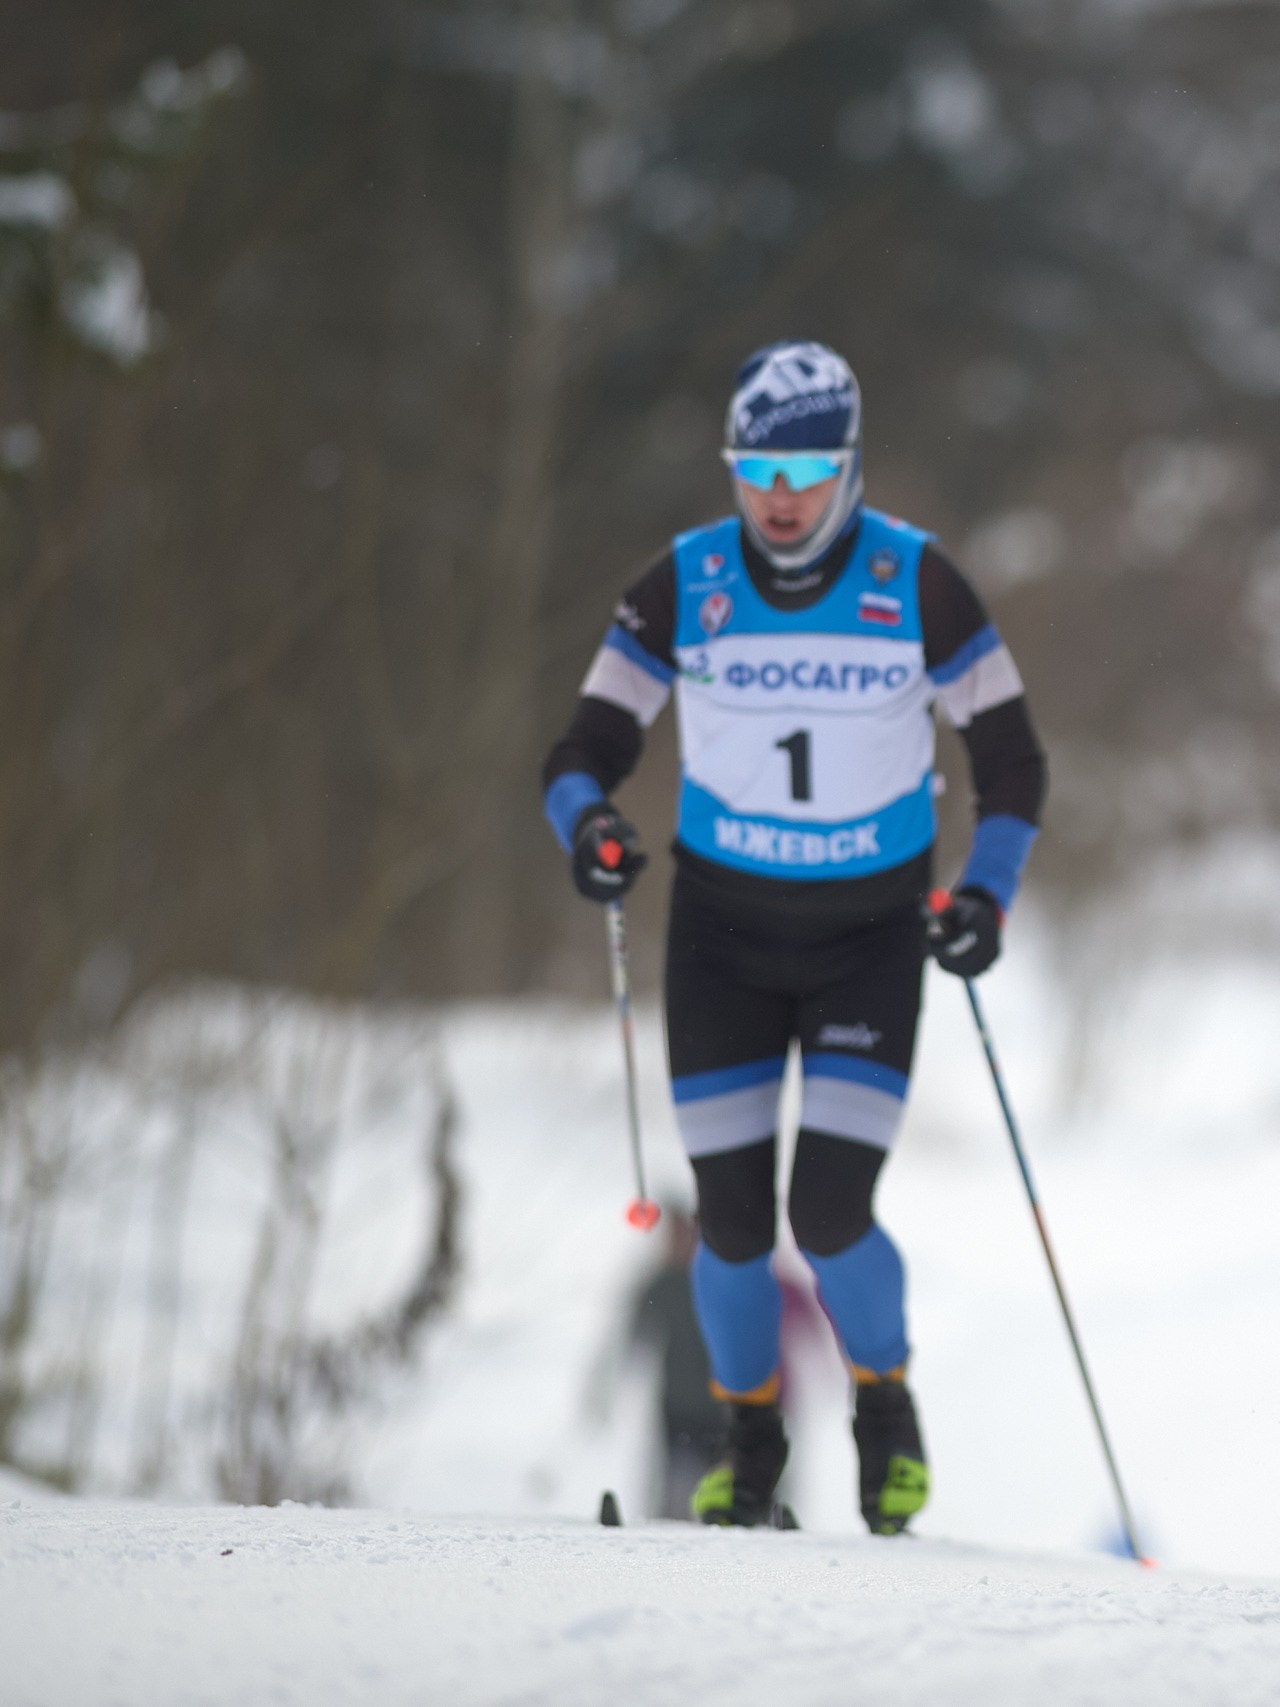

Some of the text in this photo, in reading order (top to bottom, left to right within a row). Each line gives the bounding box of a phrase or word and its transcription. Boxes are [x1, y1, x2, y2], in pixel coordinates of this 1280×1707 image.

[725, 660, 908, 691] ФОСАГРО
[774, 728, 811, 803] 1
[714, 816, 881, 866] ИЖЕВСК
